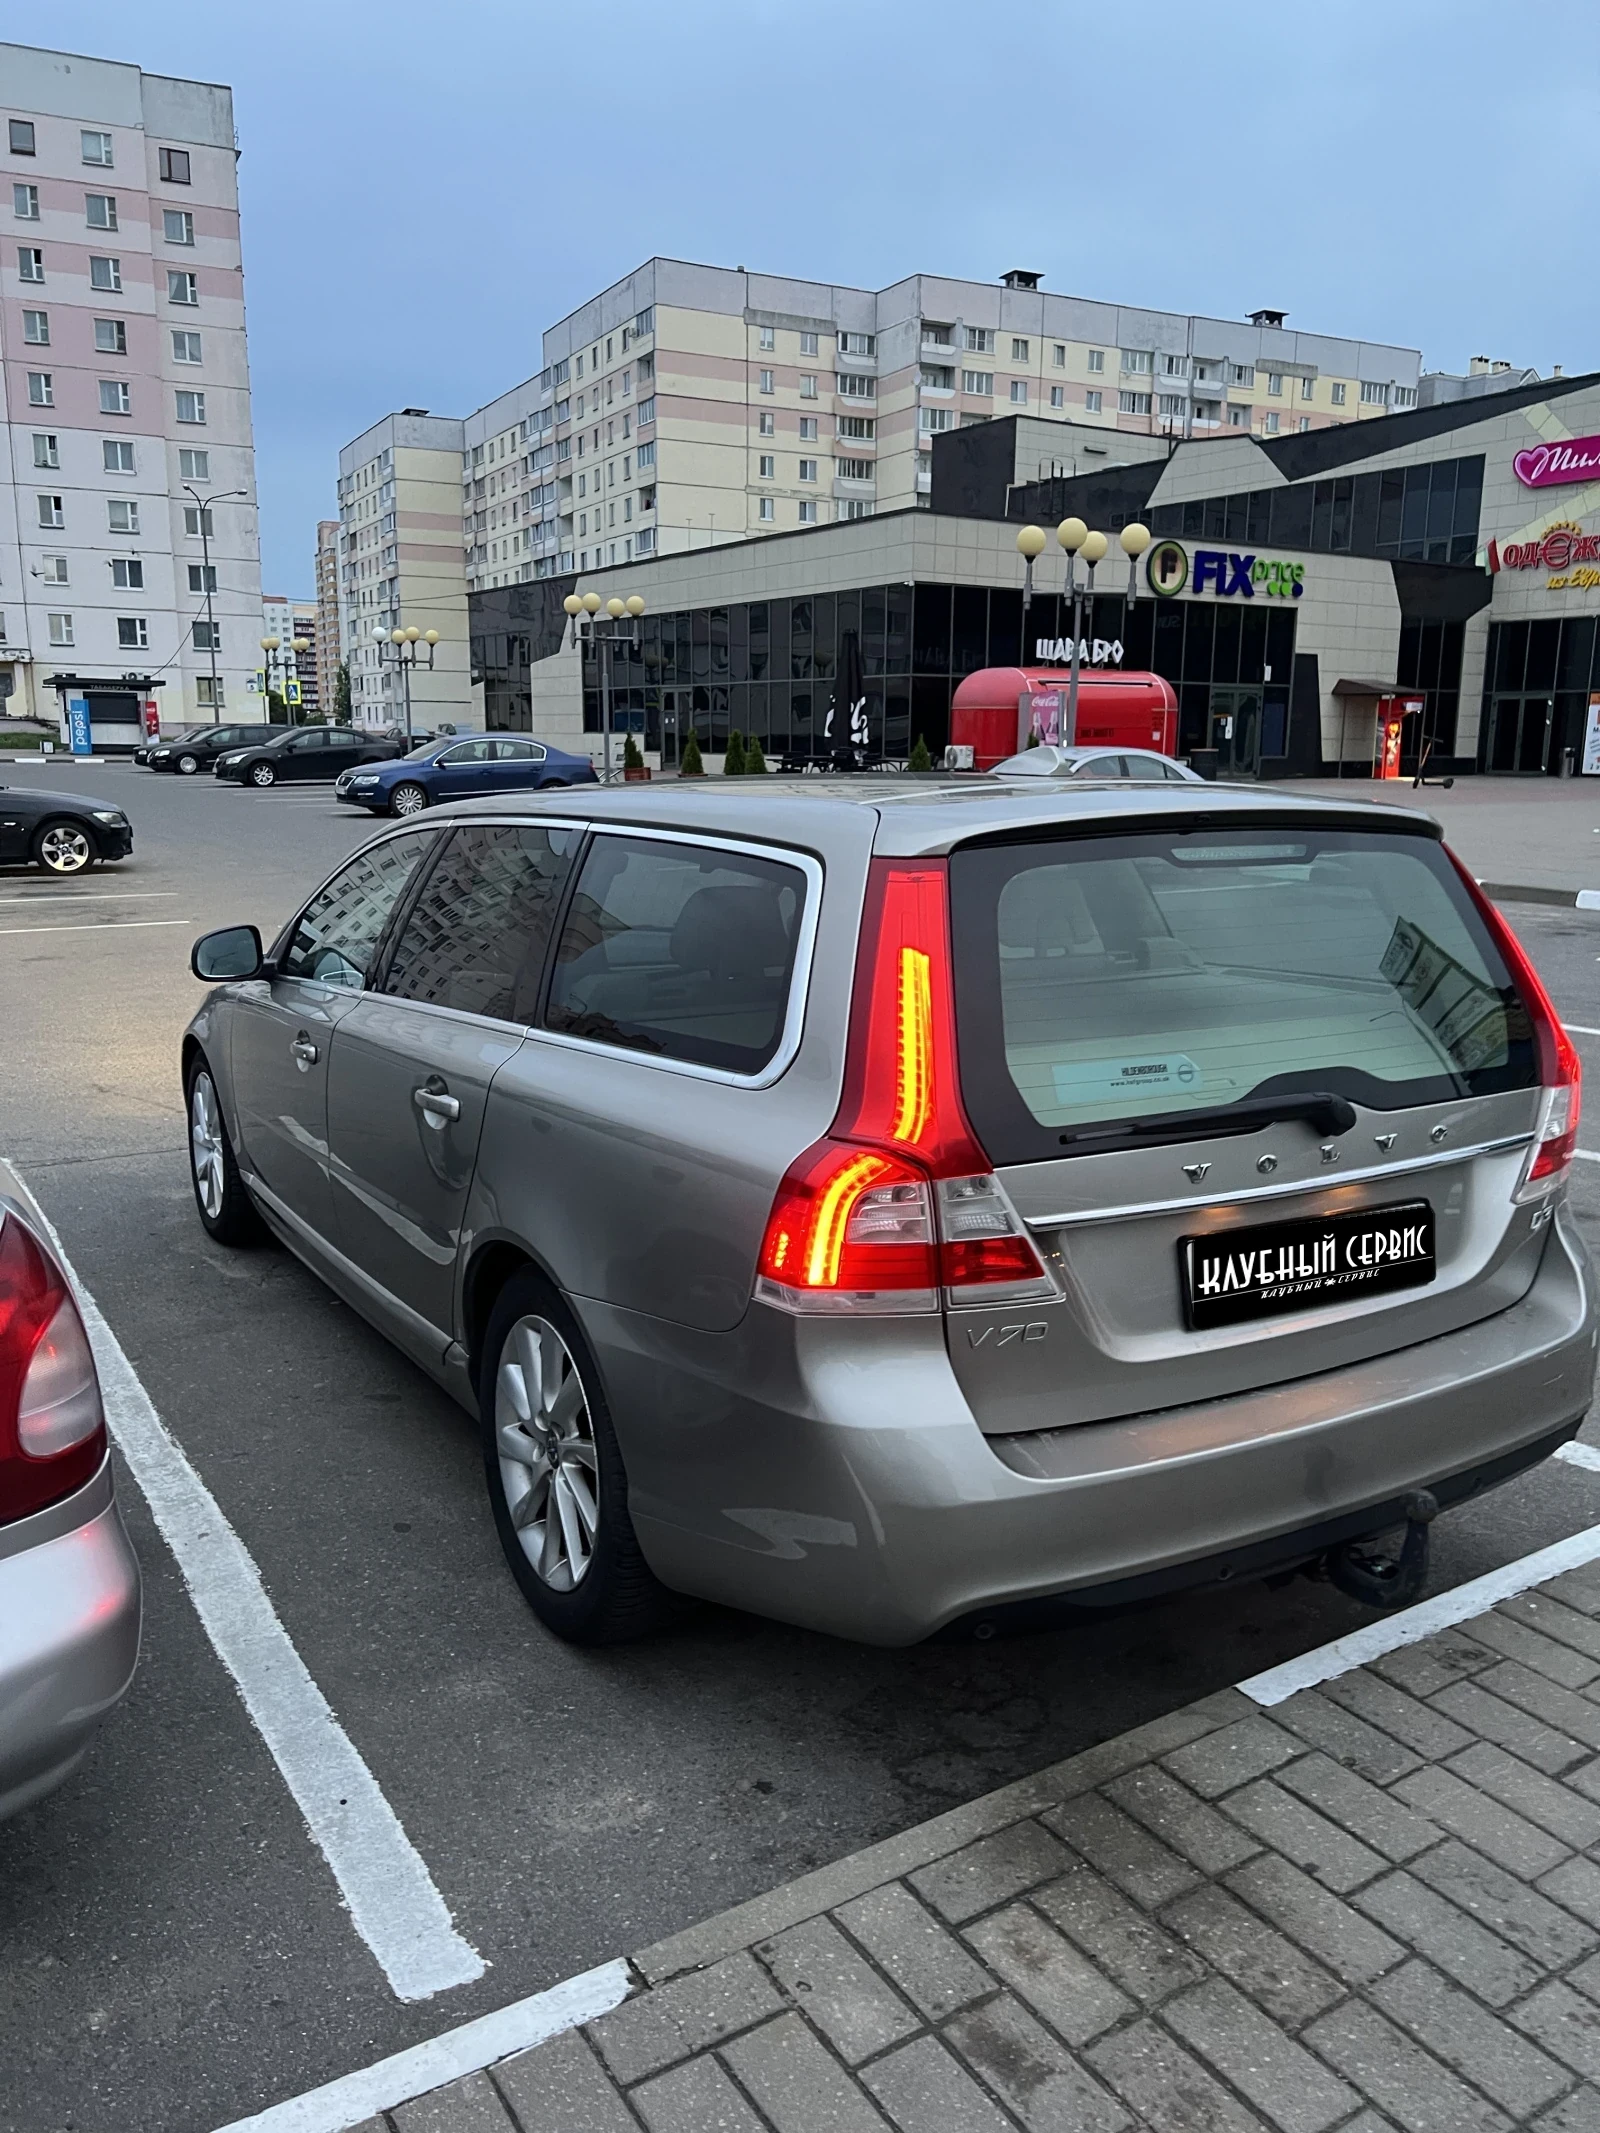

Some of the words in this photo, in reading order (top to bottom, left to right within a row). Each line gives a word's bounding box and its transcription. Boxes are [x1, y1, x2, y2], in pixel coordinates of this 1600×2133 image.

[1252, 559, 1305, 583] price
[1092, 638, 1124, 663] БРО
[72, 710, 88, 745] pepsi
[1181, 1124, 1449, 1184] VOLVO
[967, 1321, 1049, 1349] V70
